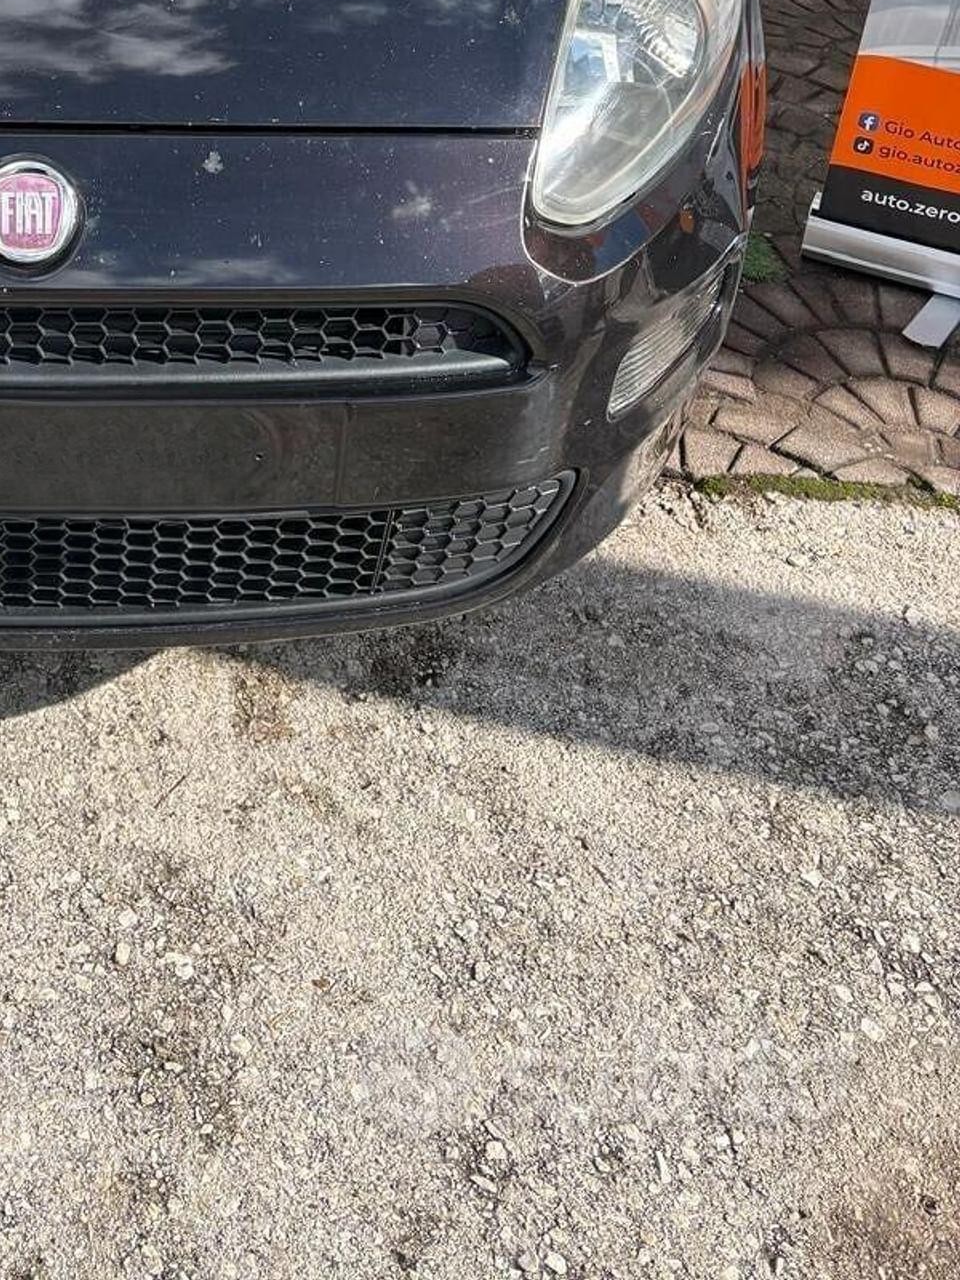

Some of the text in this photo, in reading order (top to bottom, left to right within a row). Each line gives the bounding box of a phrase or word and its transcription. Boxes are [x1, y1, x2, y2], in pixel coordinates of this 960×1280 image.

[884, 120, 915, 139] Gio
[1, 191, 55, 235] FIAT
[860, 190, 960, 223] auto.zero
